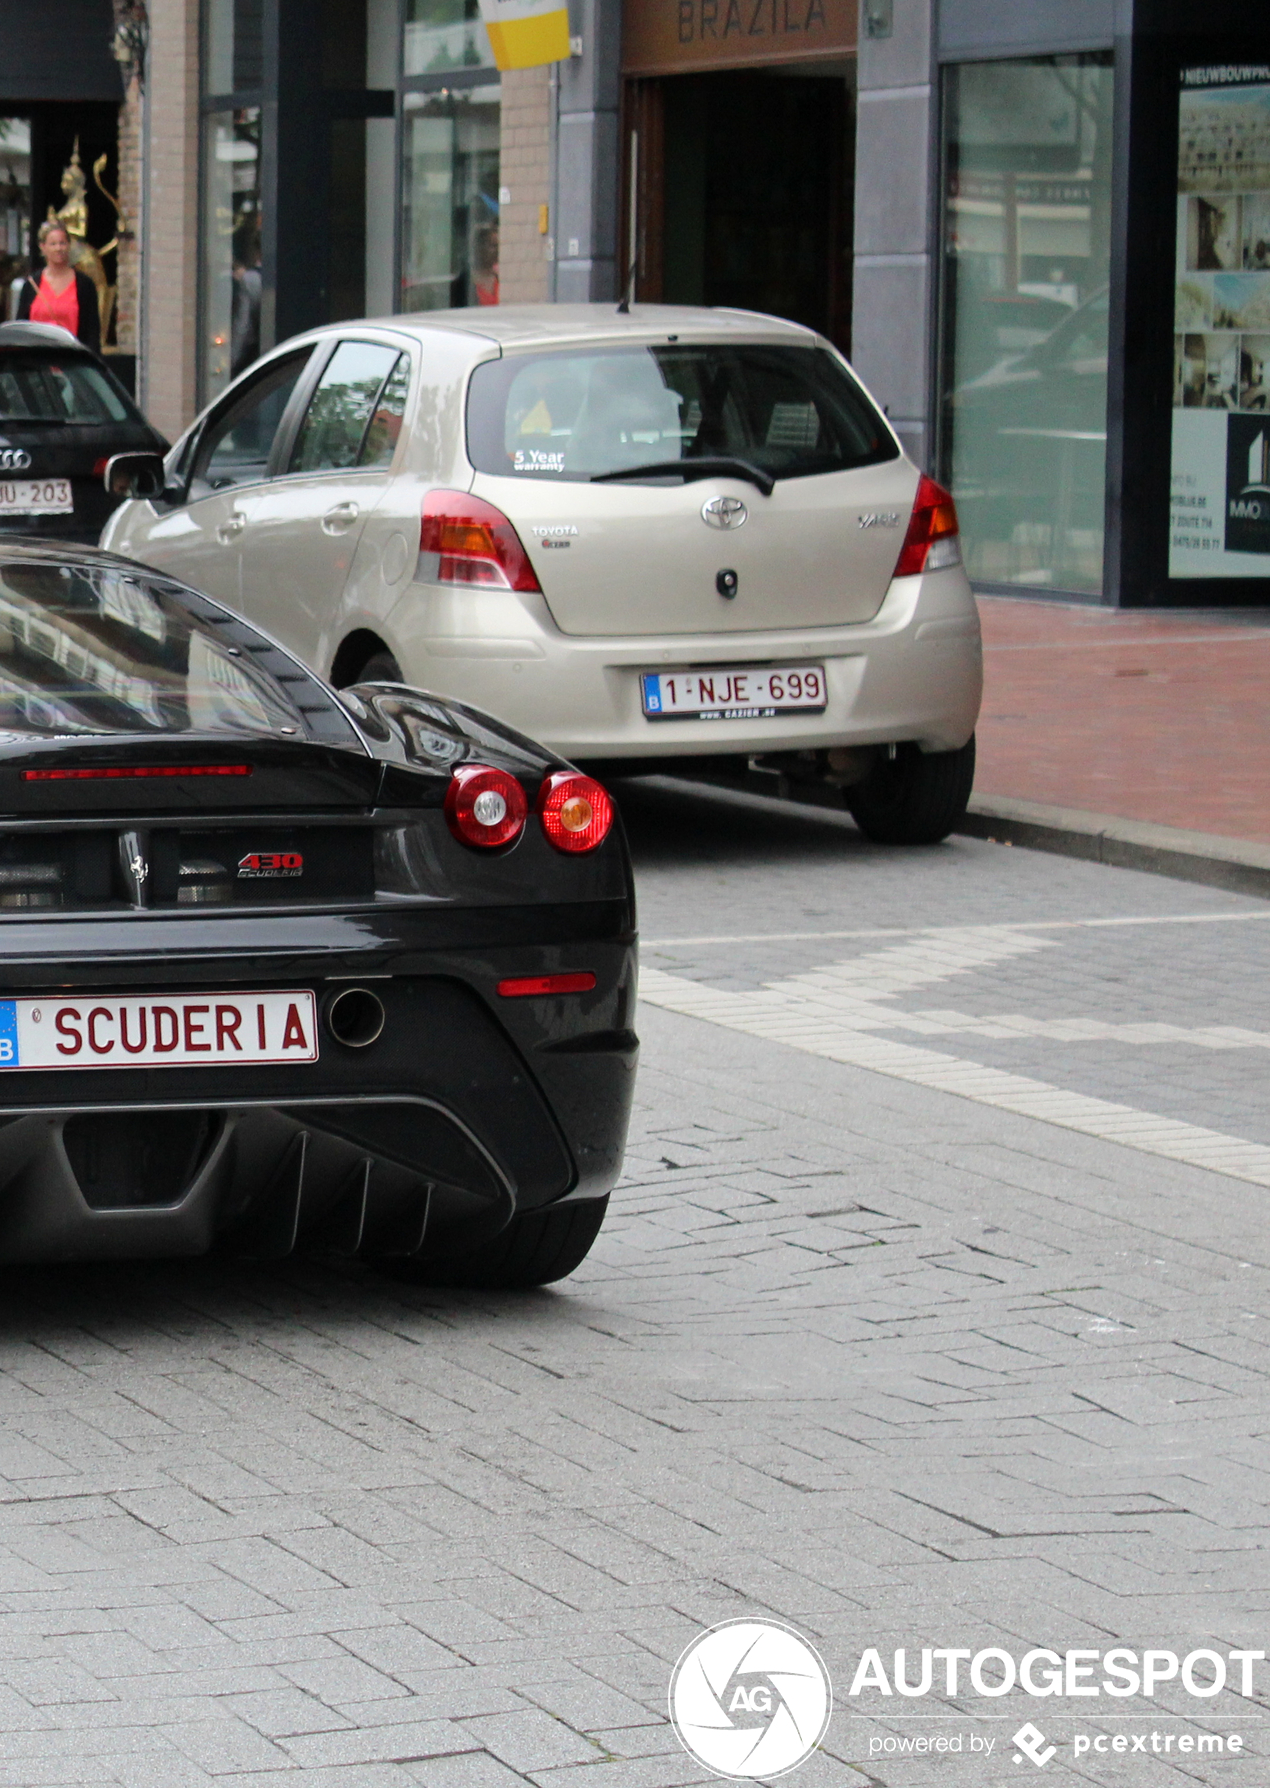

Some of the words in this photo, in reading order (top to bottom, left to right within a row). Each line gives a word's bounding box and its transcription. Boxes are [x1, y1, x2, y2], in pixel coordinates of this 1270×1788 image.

[678, 0, 826, 43] BRAZILA
[515, 451, 524, 464] 5
[529, 450, 565, 463] Year
[514, 463, 565, 472] warranty
[532, 525, 578, 536] TOYOTA
[666, 673, 821, 706] 1-NJE-699
[649, 697, 660, 710] B
[238, 852, 303, 869] 430
[55, 1003, 308, 1056] SCUDERIA
